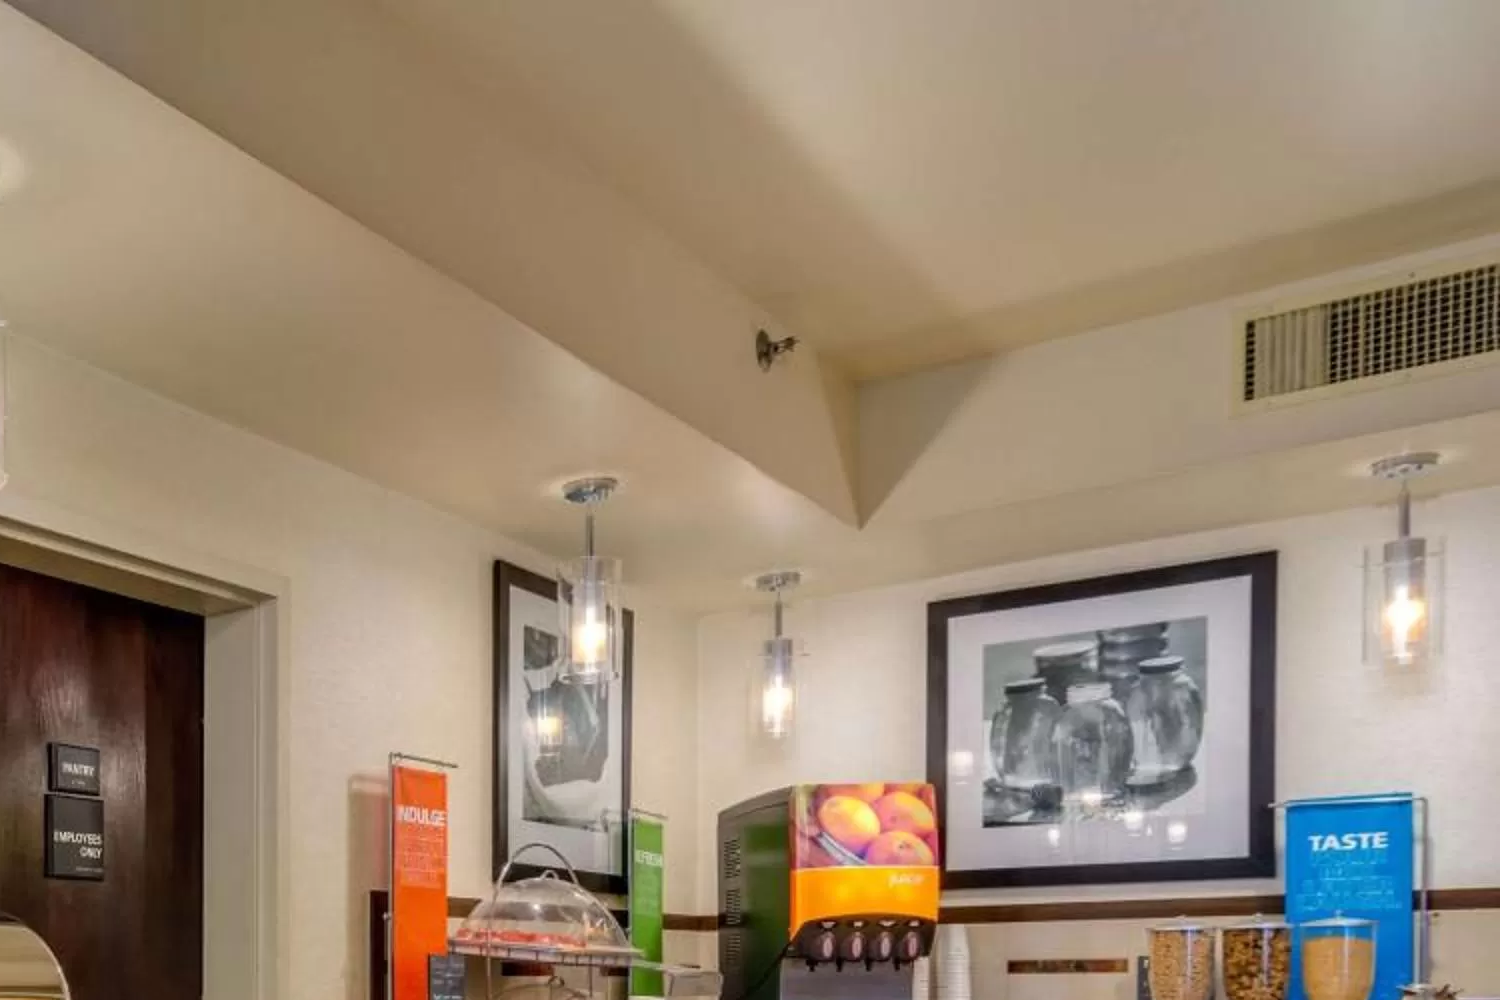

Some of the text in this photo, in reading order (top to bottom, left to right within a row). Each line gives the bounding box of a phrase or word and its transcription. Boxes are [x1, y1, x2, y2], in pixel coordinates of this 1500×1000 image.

[53, 830, 102, 845] EMPLOYEES
[1307, 831, 1390, 852] TASTE
[79, 845, 102, 860] ONLY
